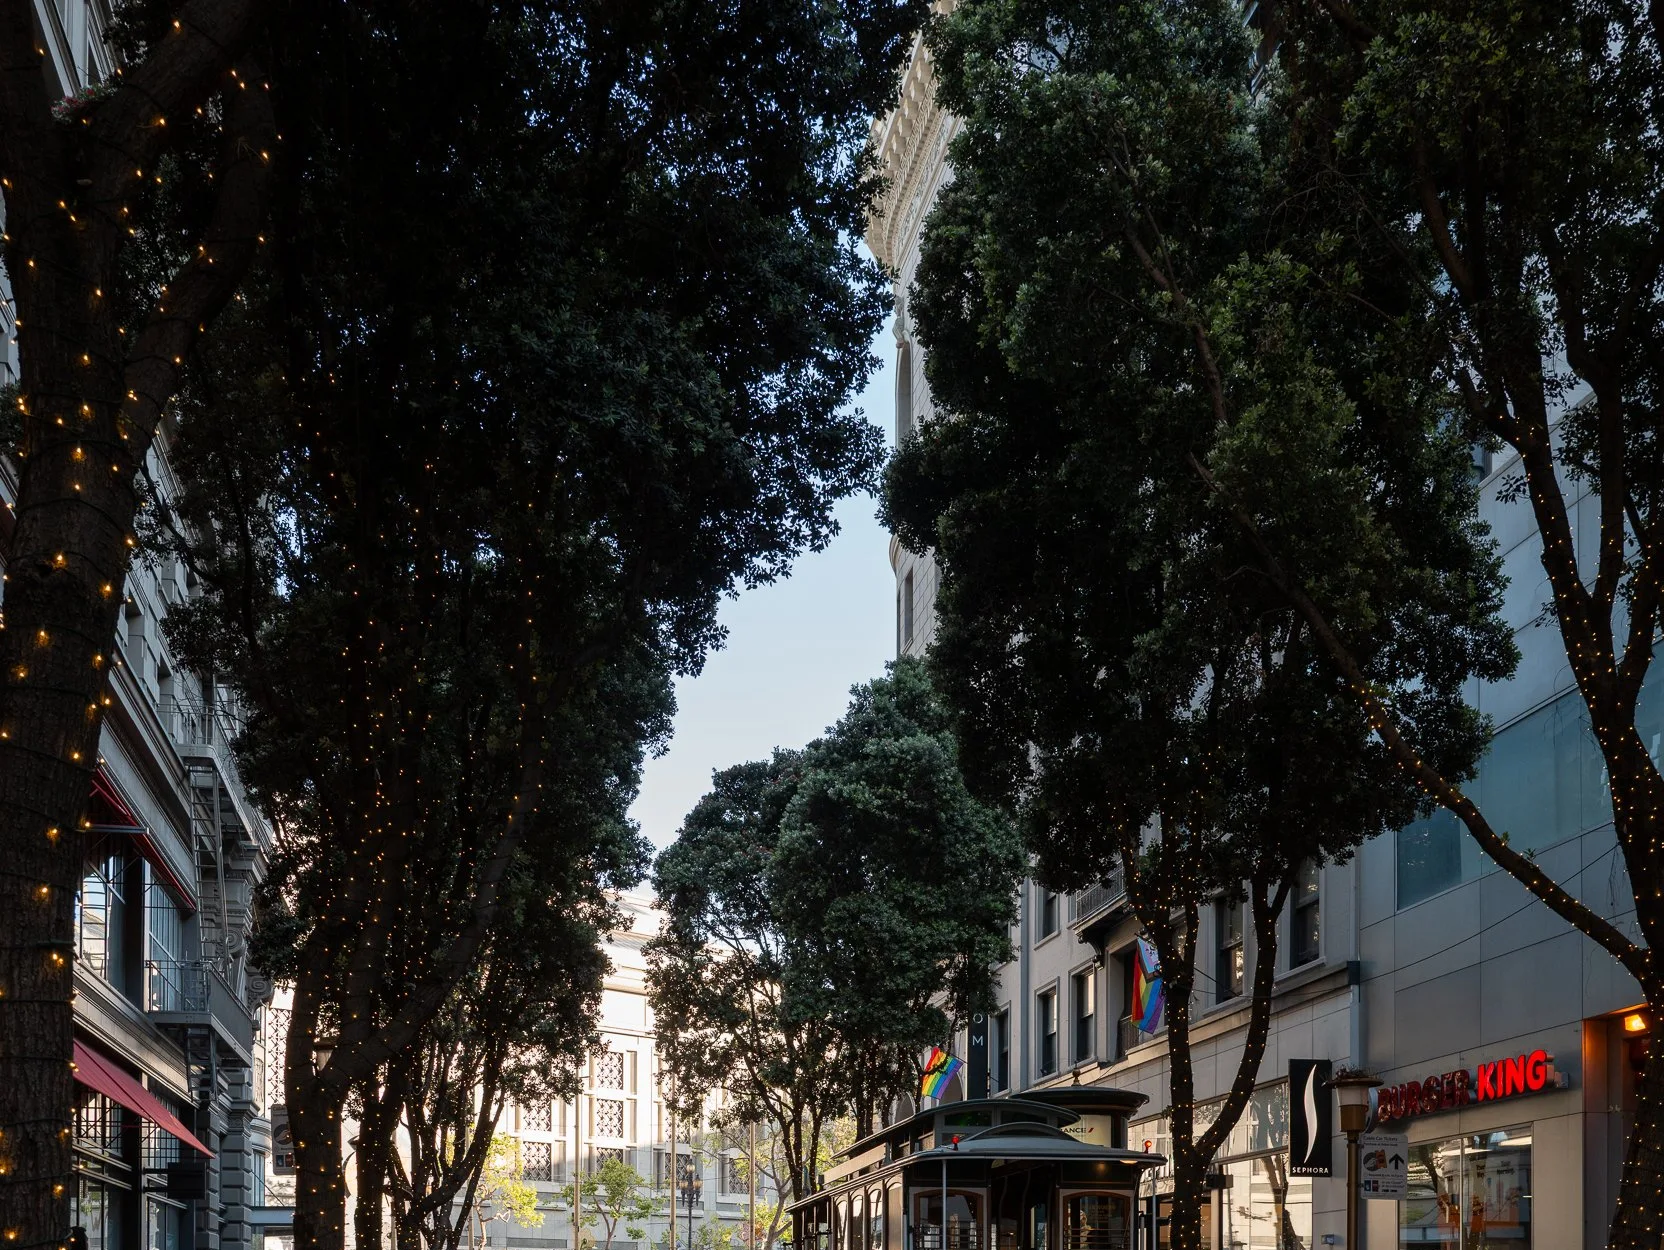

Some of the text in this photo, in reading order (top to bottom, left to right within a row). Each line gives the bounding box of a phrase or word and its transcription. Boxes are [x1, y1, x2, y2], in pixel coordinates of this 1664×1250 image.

[972, 1012, 984, 1046] OM
[1377, 1049, 1548, 1123] BURGER KING
[1291, 1166, 1329, 1174] SEPHORA
